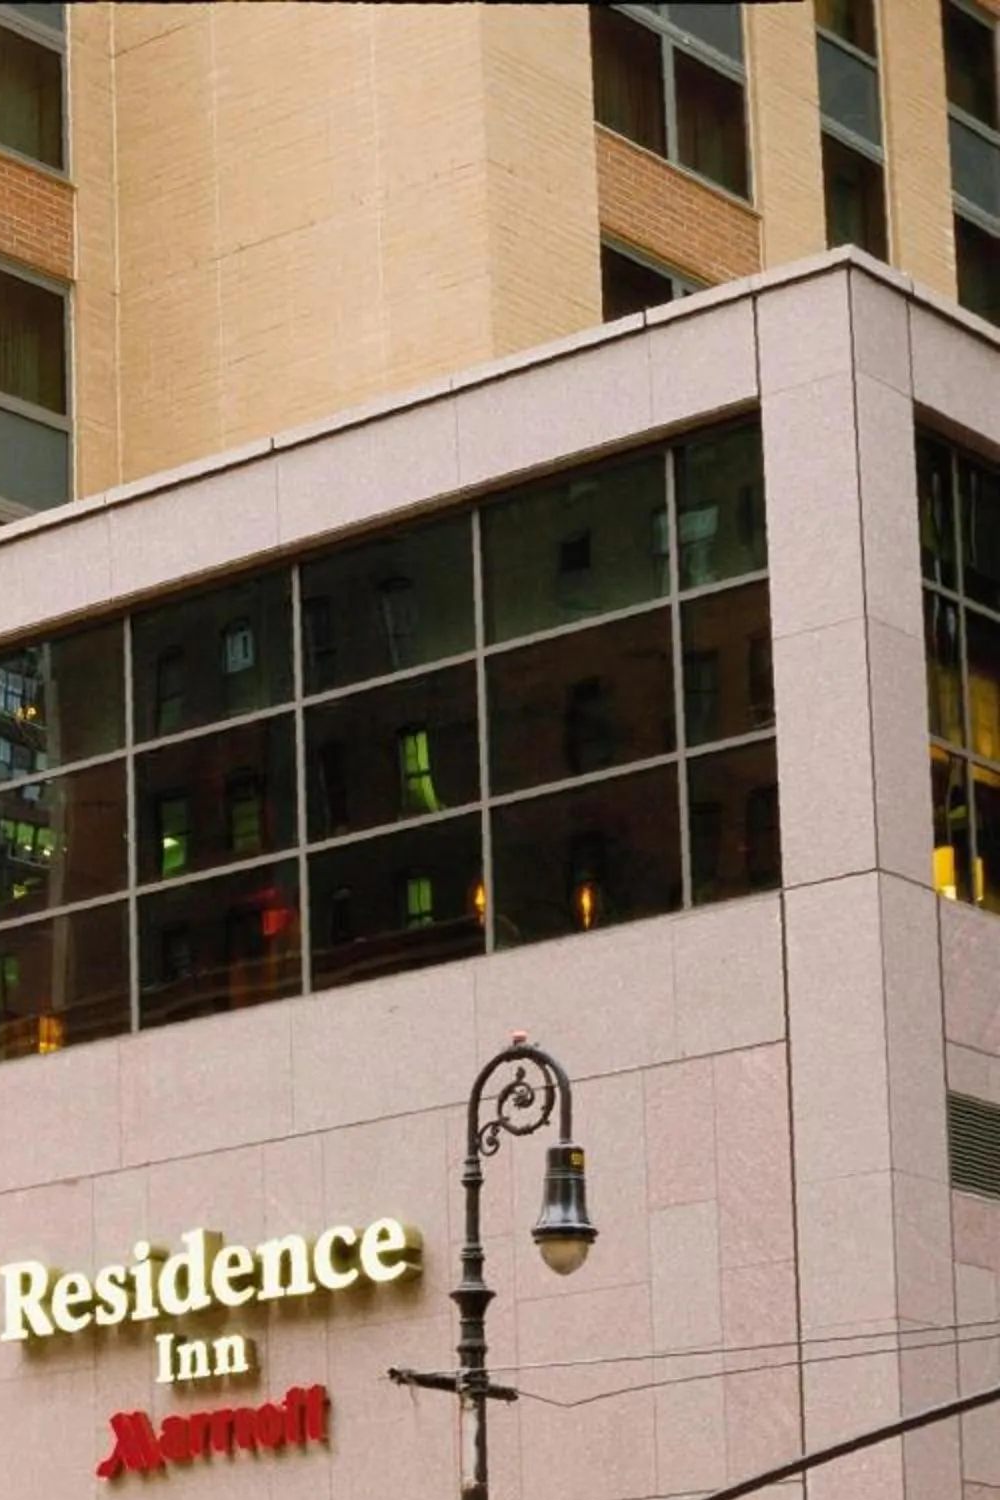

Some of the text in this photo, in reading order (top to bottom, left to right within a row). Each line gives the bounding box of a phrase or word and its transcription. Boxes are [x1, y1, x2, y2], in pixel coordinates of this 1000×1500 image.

[0, 1217, 412, 1341] Residence
[154, 1333, 250, 1384] Inn
[96, 1384, 329, 1479] Marriott
